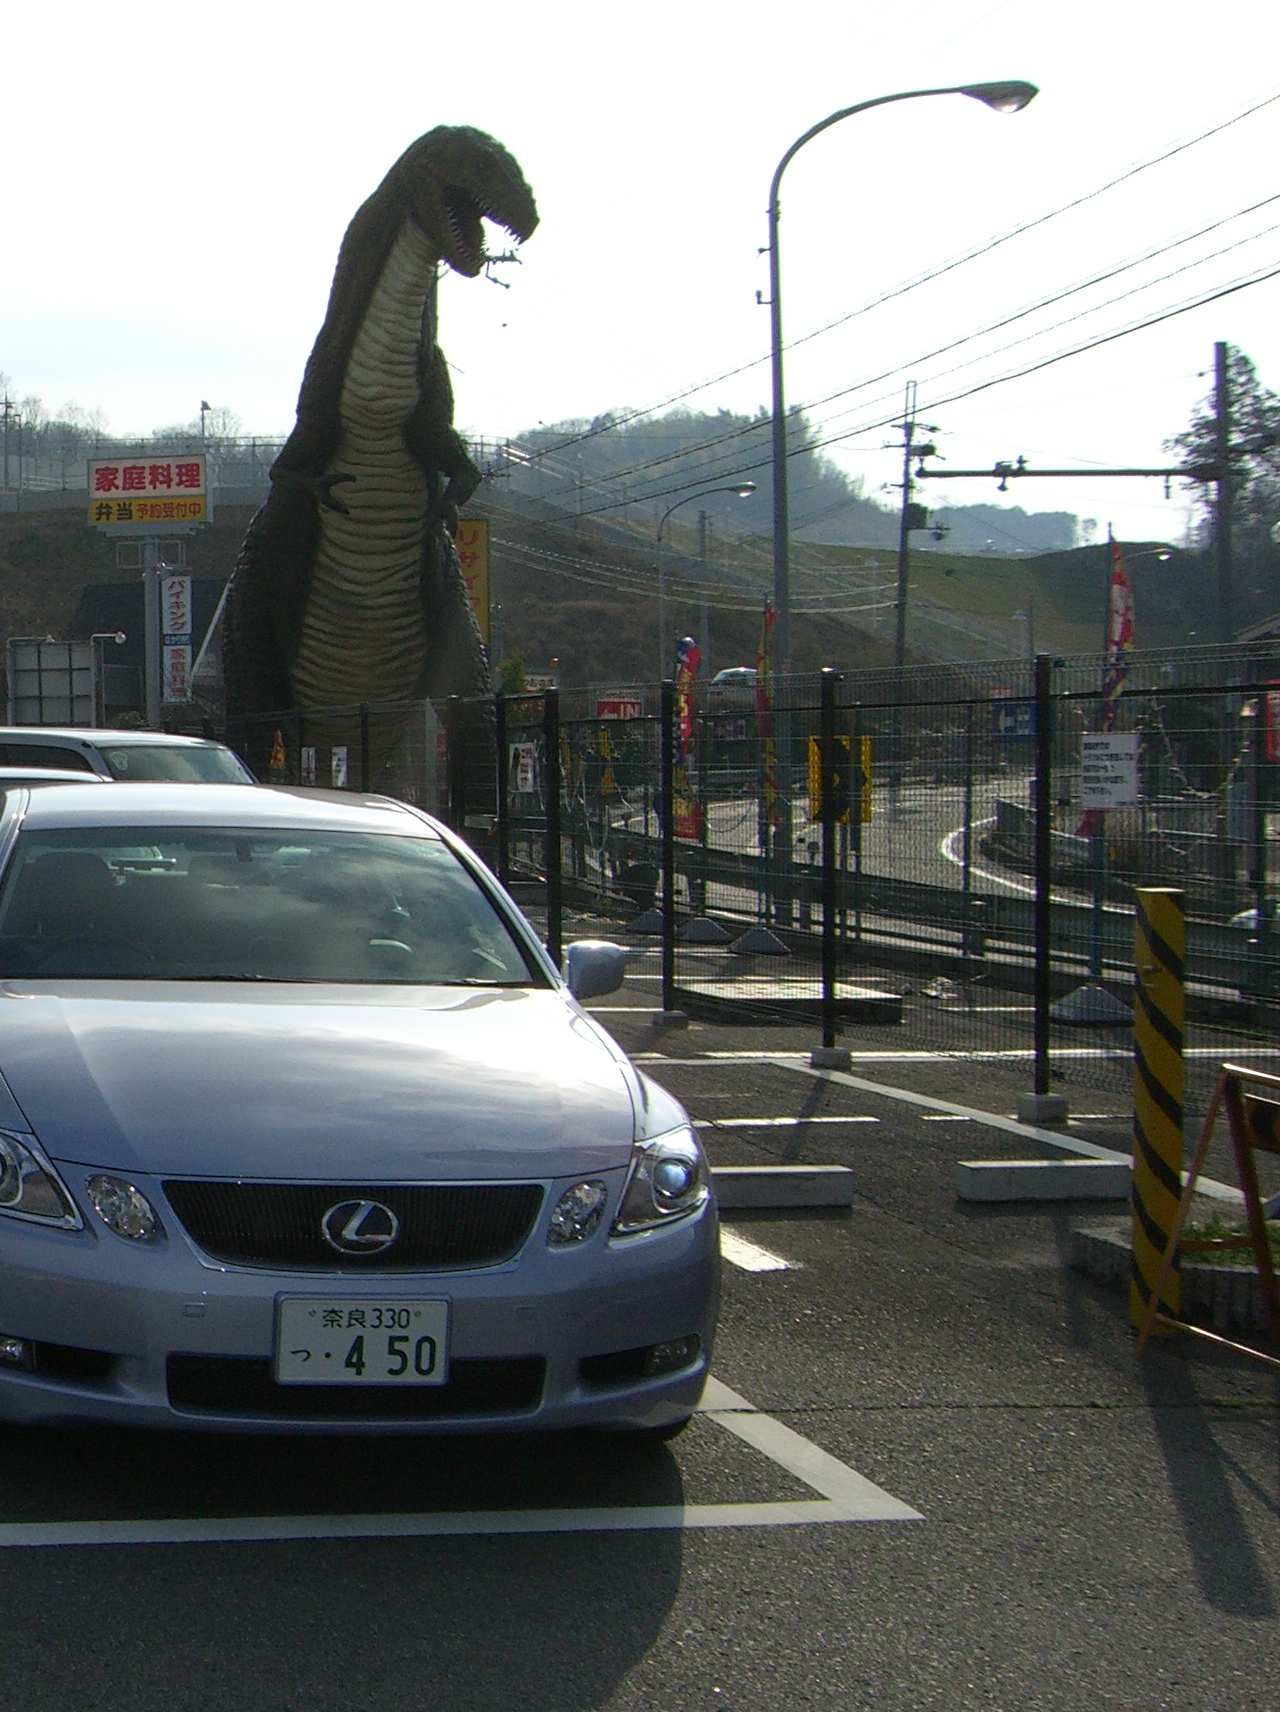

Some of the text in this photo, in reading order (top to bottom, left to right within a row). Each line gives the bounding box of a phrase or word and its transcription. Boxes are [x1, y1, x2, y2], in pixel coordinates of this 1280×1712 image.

[95, 463, 201, 492] 家庭料理
[167, 579, 187, 632] バイキング
[323, 1308, 410, 1329] 奈良330
